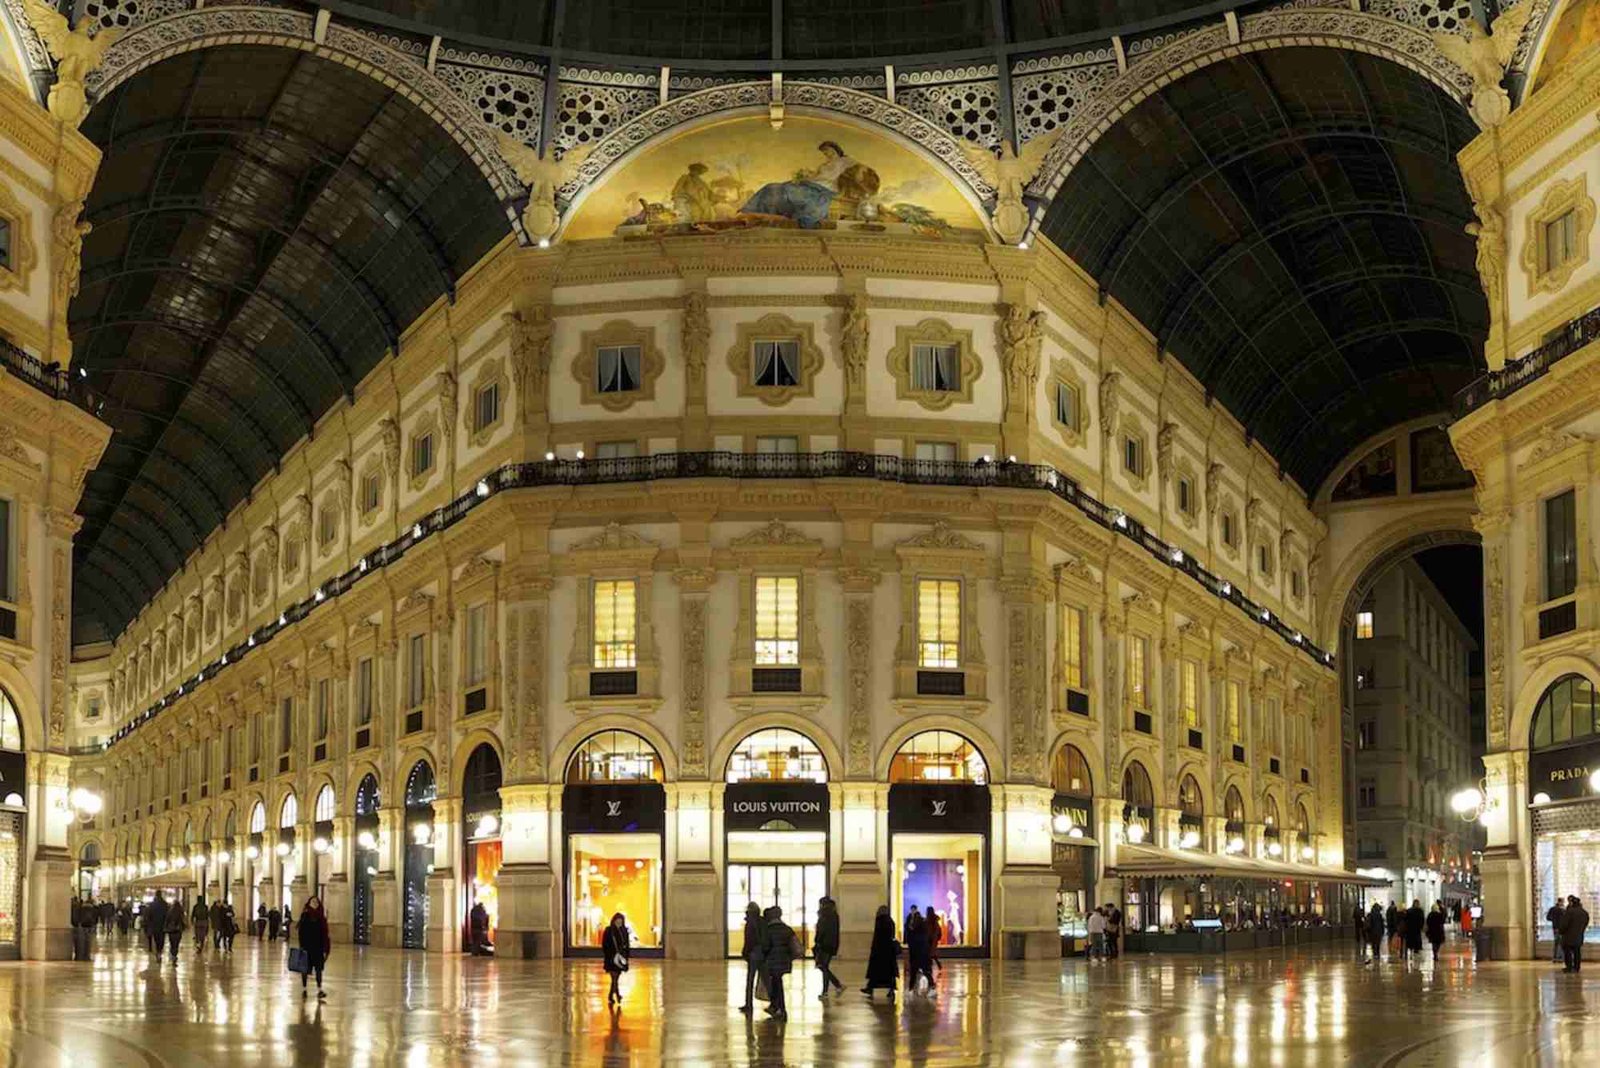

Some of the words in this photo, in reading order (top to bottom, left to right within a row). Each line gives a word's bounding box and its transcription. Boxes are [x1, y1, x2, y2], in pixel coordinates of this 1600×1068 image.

[1550, 766, 1589, 781] PRADA
[733, 802, 767, 812] LOUIS
[769, 802, 820, 812] VUITTON
